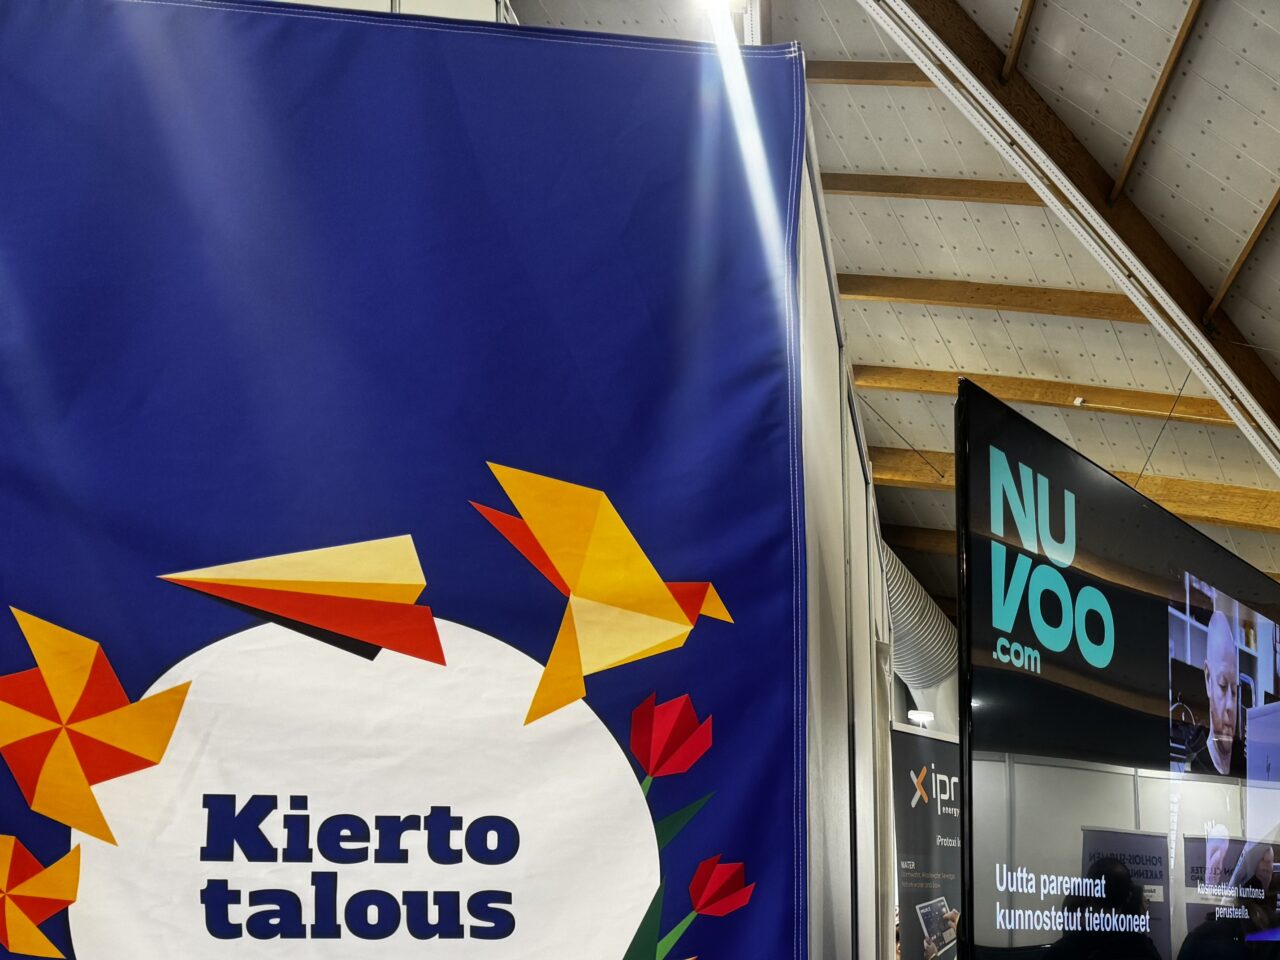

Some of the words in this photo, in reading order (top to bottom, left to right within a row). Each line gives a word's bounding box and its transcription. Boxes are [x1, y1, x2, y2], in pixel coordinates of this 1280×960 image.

[989, 444, 1076, 569] NU
[991, 540, 1115, 669] VOO
[992, 636, 1041, 674] .com
[200, 793, 520, 865] Kierto
[900, 861, 915, 869] WATER
[995, 863, 1036, 894] Uutta
[1040, 874, 1106, 901] paremmat
[200, 871, 516, 940] talous
[996, 902, 1082, 931] kunnostetut
[1085, 907, 1150, 932] tietokoneet
[1215, 905, 1249, 921] perusteella.
